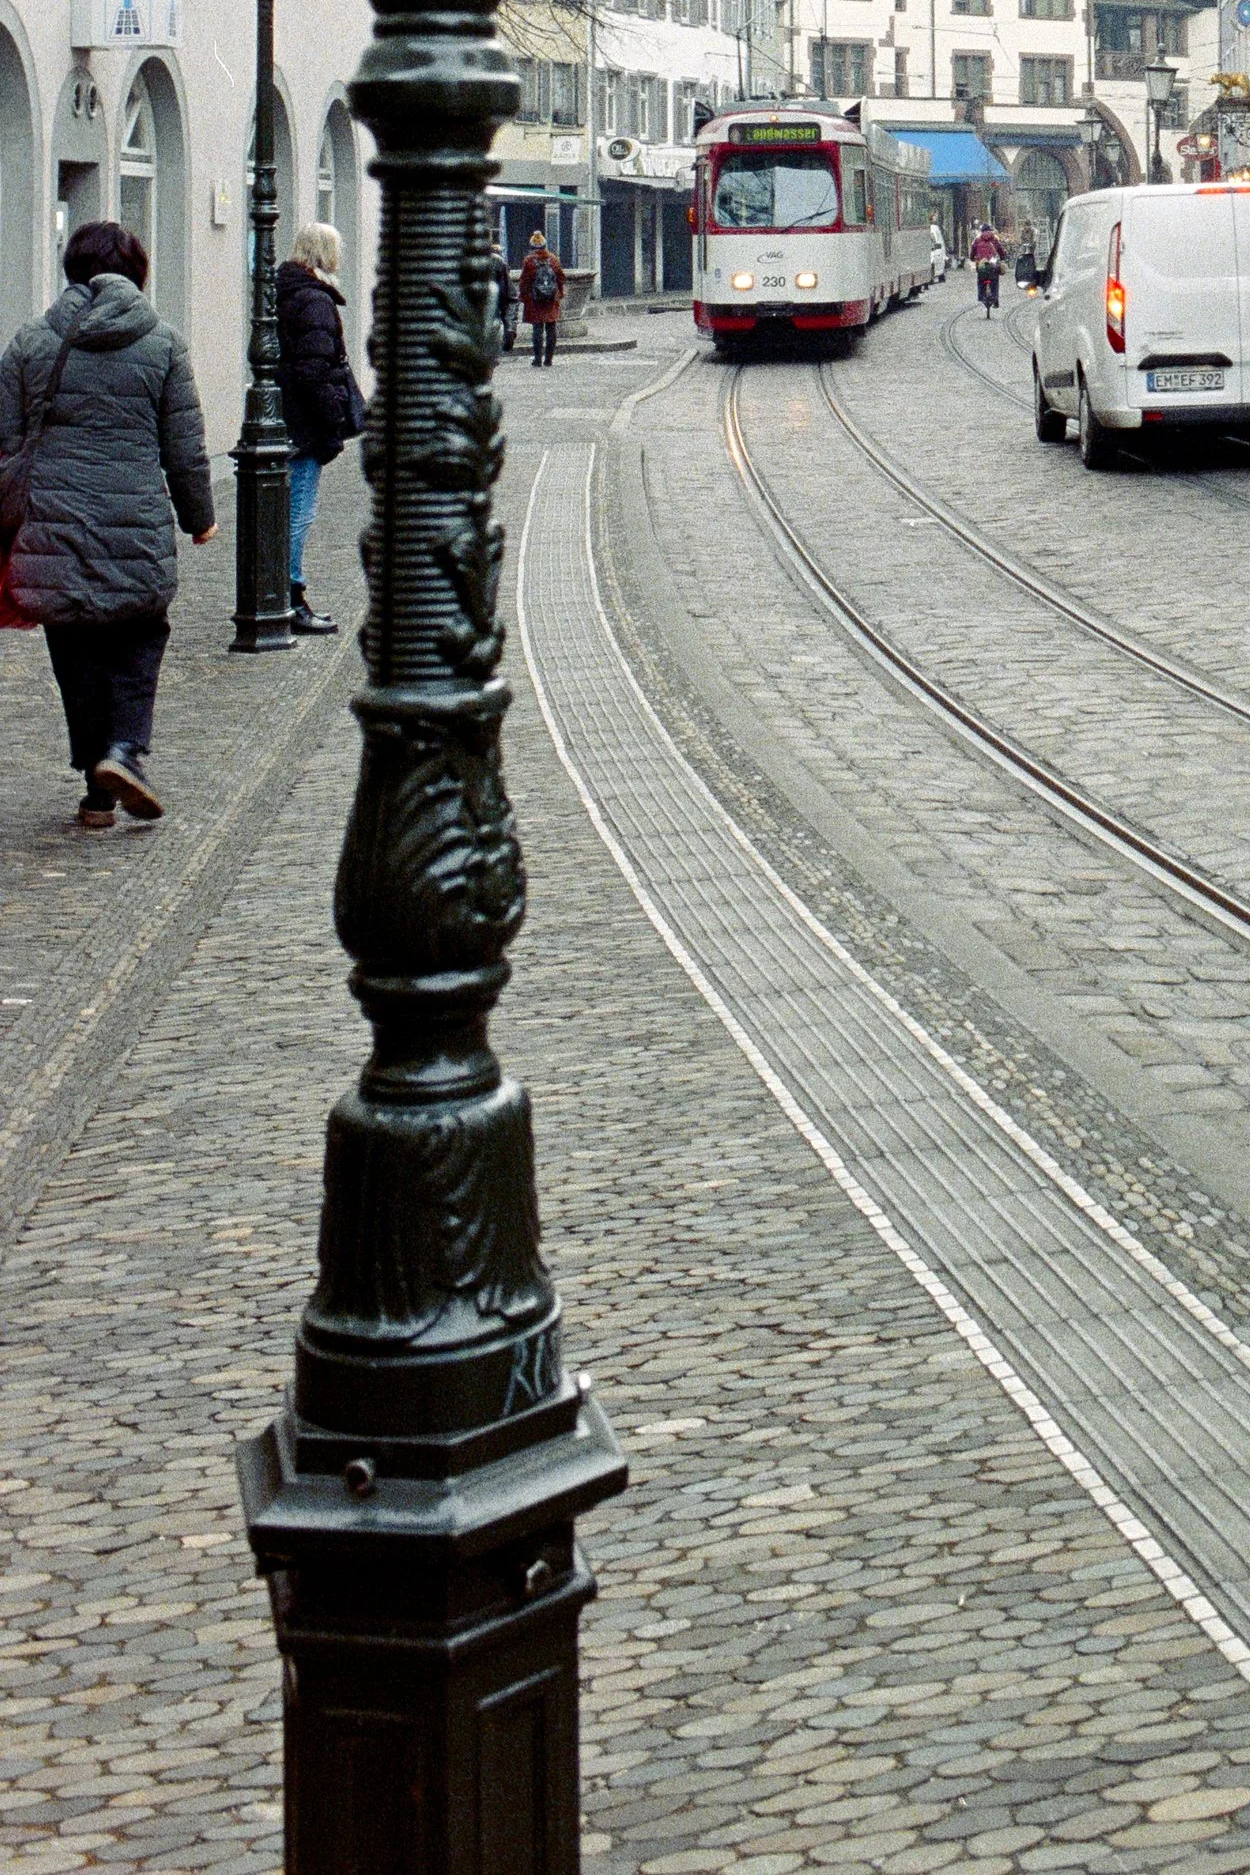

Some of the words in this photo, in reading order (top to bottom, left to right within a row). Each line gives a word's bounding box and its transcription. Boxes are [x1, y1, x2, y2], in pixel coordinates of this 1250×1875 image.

[765, 251, 784, 259] VAG
[762, 276, 786, 288] 230
[1156, 374, 1174, 388] EM
[1199, 372, 1222, 386] 392
